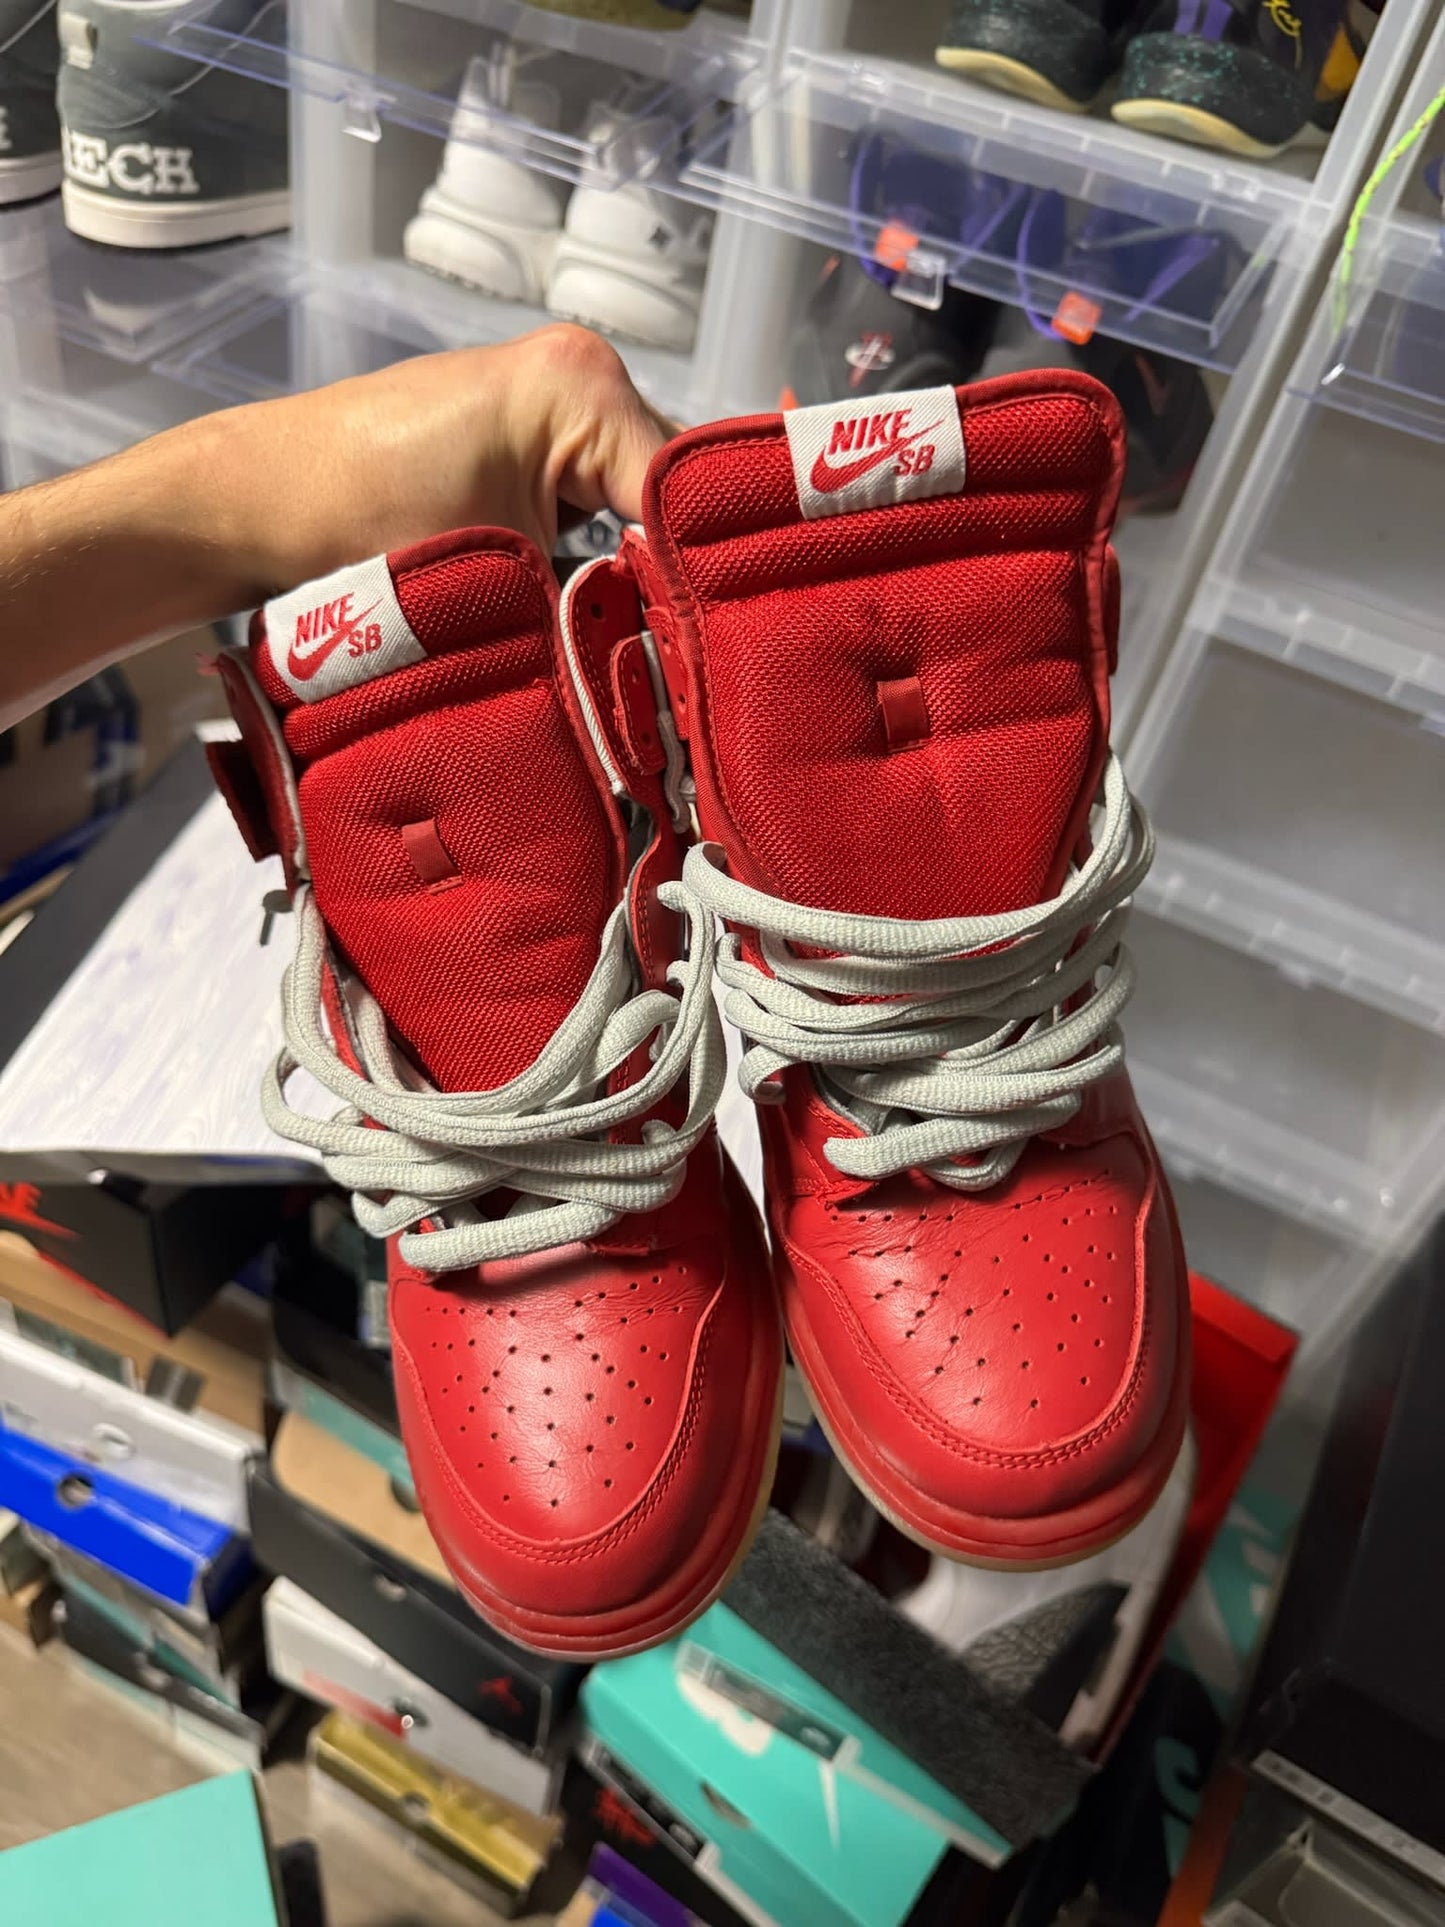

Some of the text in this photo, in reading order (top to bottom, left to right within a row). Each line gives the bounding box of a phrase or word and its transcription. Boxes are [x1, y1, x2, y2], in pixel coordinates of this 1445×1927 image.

[61, 127, 200, 195] ECH
[827, 408, 913, 456] NIKE
[893, 444, 936, 477] SB
[295, 591, 356, 648] NIKE
[347, 623, 383, 659] SB
